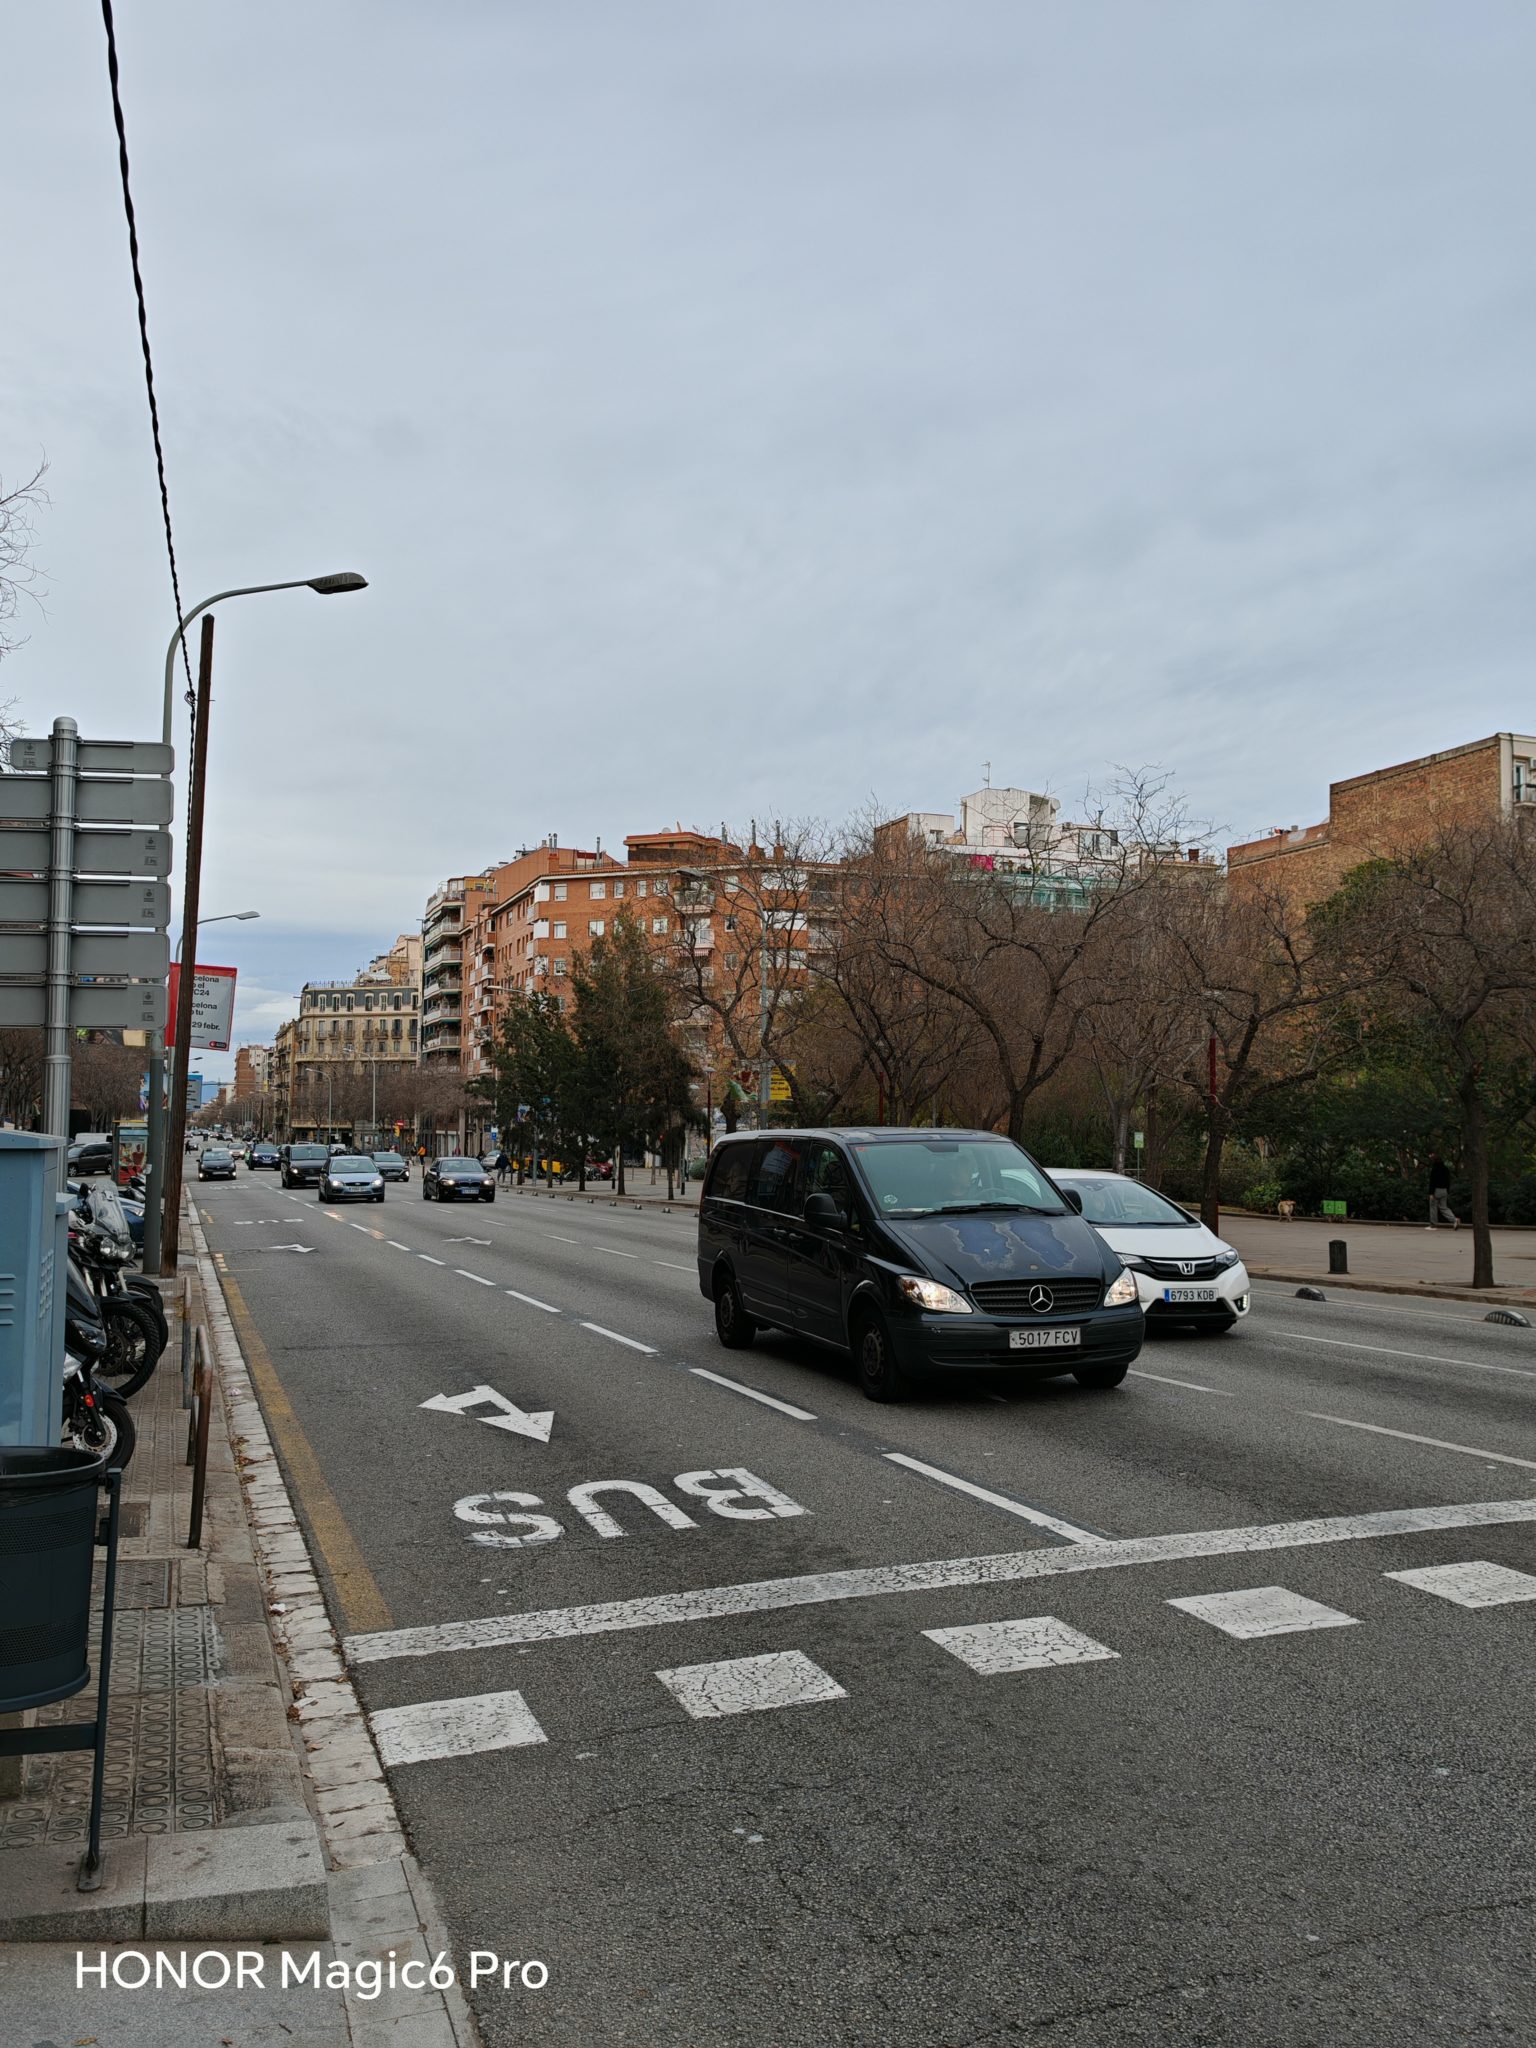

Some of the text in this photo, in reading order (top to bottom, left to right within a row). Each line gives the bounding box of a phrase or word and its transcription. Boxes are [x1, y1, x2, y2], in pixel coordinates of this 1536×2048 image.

[194, 975, 220, 983] celona
[192, 1002, 218, 1010] celona
[1170, 1289, 1215, 1301] 6793 KDB
[1018, 1329, 1078, 1346] 5017 FCV
[452, 1467, 812, 1548] BUS
